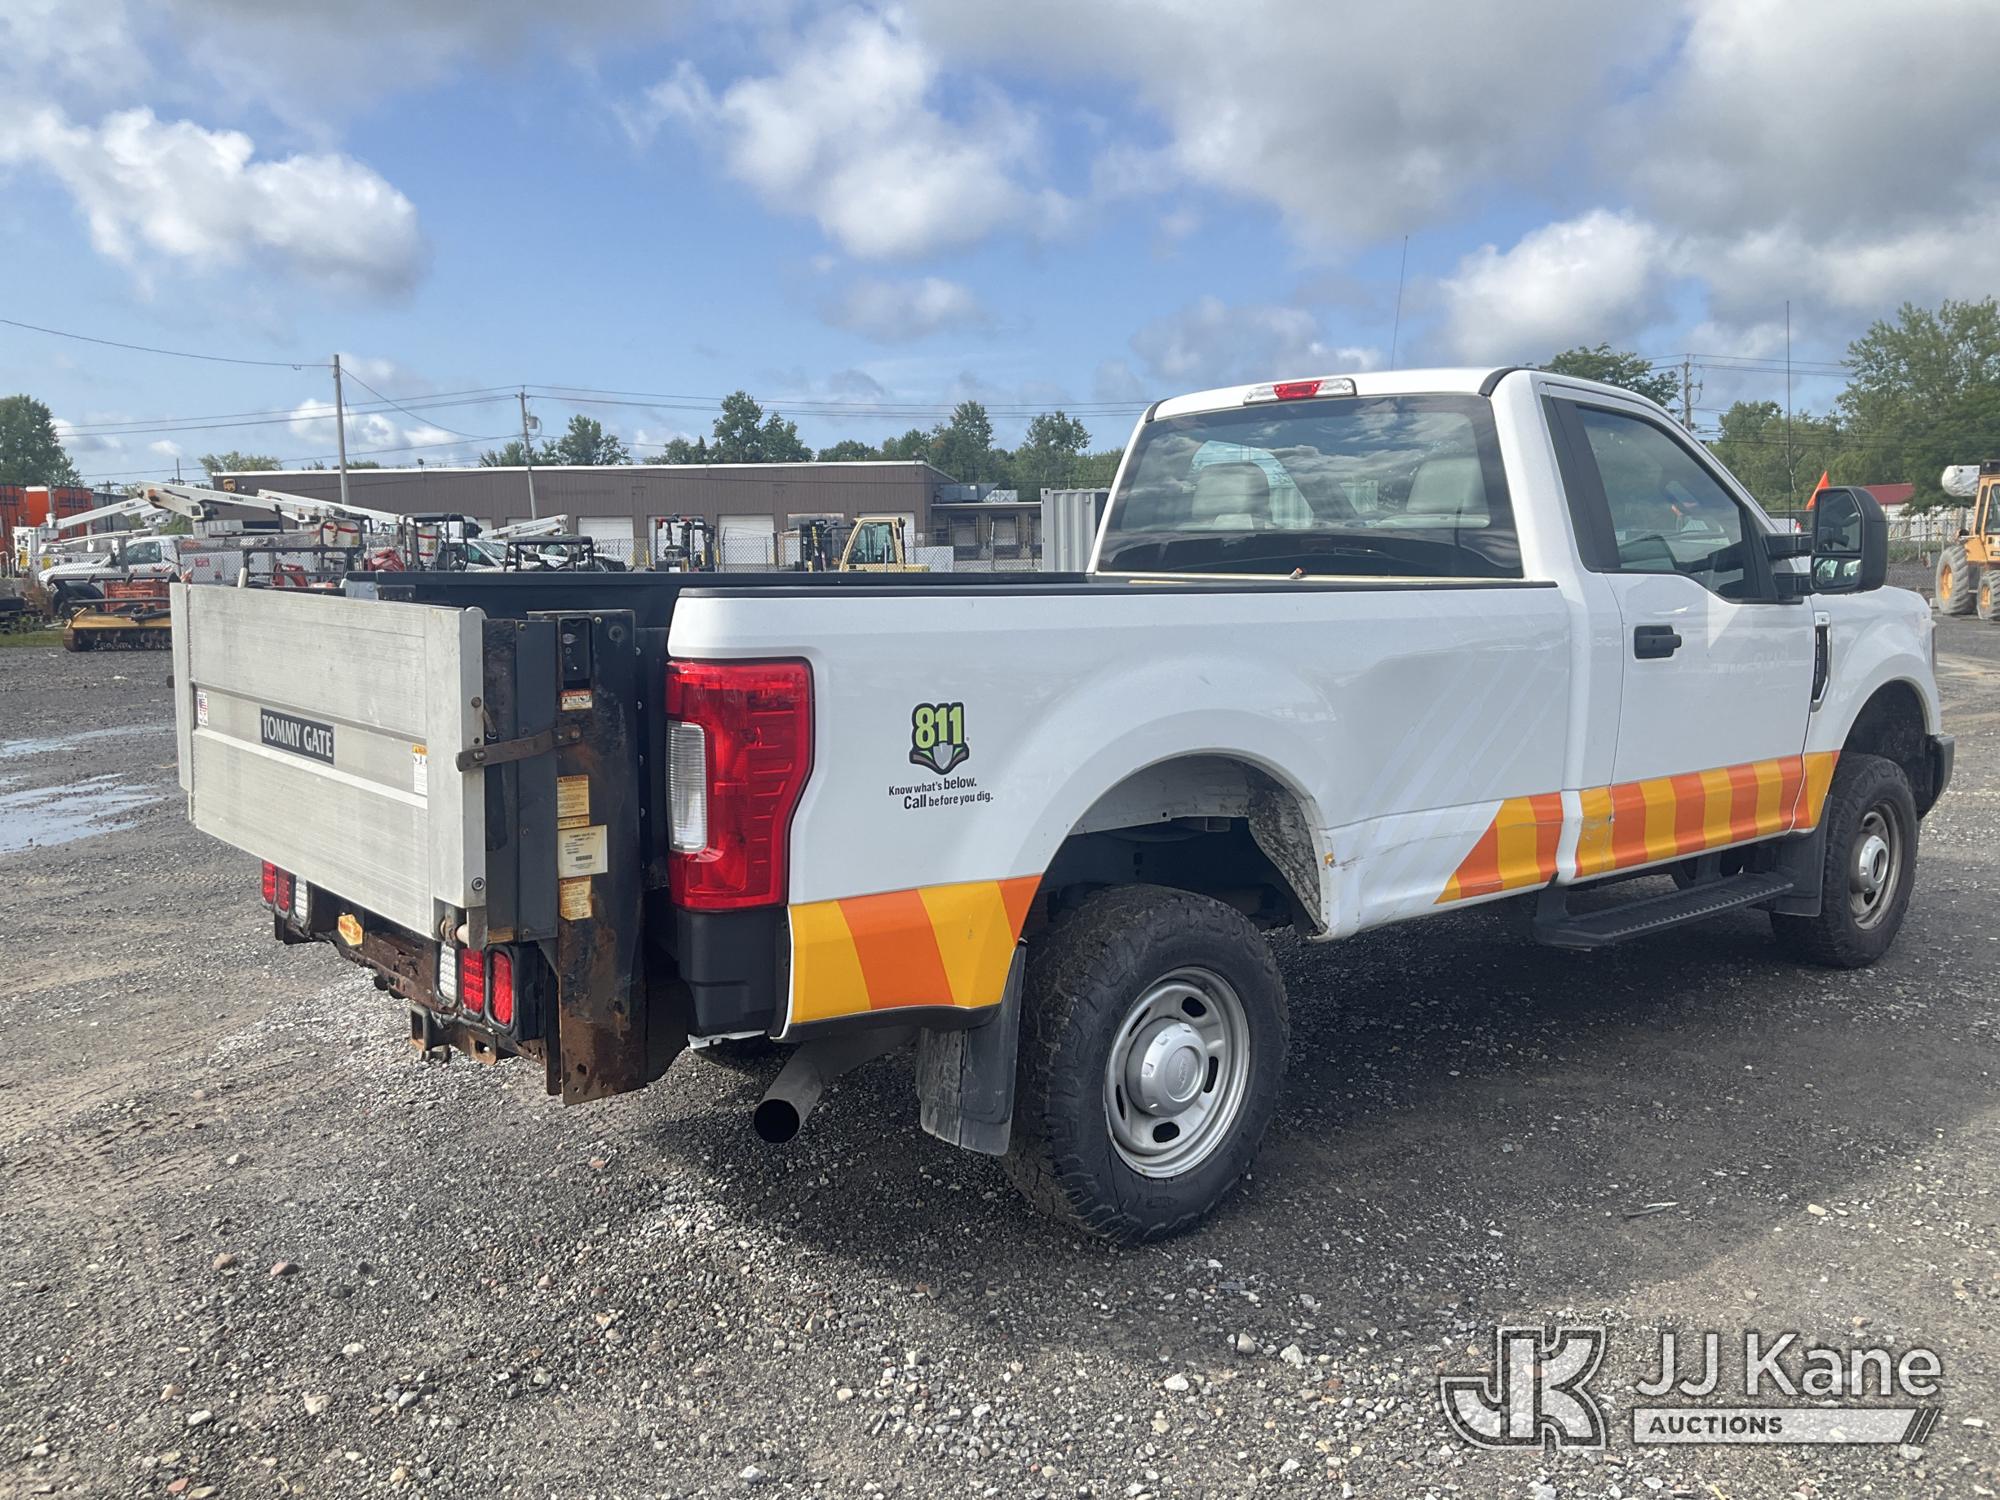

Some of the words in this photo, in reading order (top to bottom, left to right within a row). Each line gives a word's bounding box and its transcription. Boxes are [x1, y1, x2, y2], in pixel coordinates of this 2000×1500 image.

[262, 714, 301, 748] TOMMY
[303, 725, 333, 758] GATE
[913, 703, 964, 750] 811
[888, 785, 913, 796] Know
[913, 781, 942, 793] what's
[943, 777, 977, 790] below.
[903, 794, 927, 810] Call
[928, 795, 959, 807] before
[959, 795, 975, 806] you
[976, 791, 994, 803] dig.
